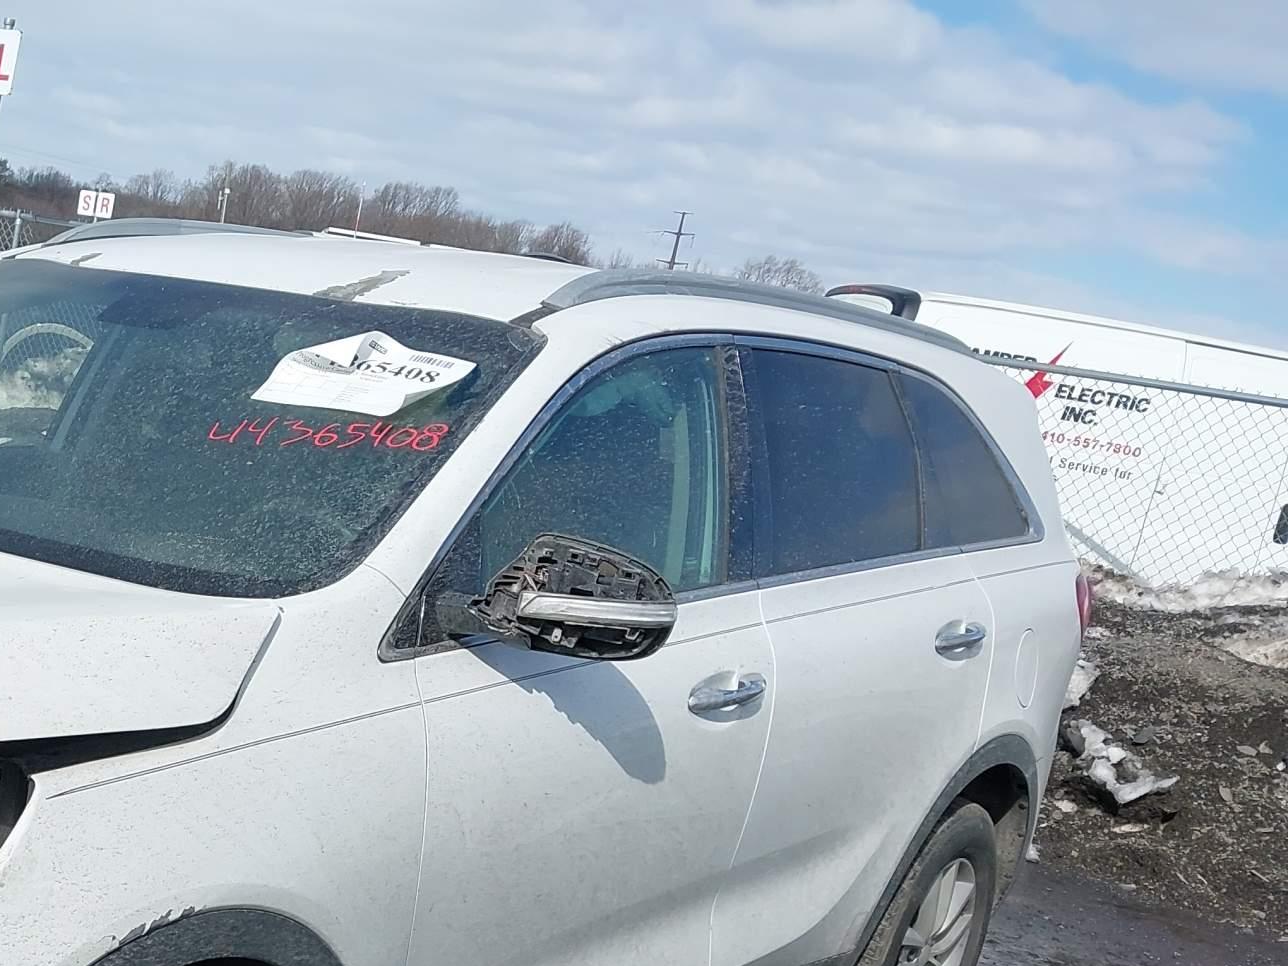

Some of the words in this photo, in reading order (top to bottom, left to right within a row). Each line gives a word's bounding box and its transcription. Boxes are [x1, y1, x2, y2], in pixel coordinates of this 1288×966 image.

[82, 194, 92, 211] S
[100, 196, 111, 214] R
[1054, 383, 1152, 414] ELECTRIC
[1060, 406, 1098, 427] INC.
[208, 416, 450, 452] 44365408
[1058, 459, 1111, 477] Service
[1114, 468, 1133, 481] for
